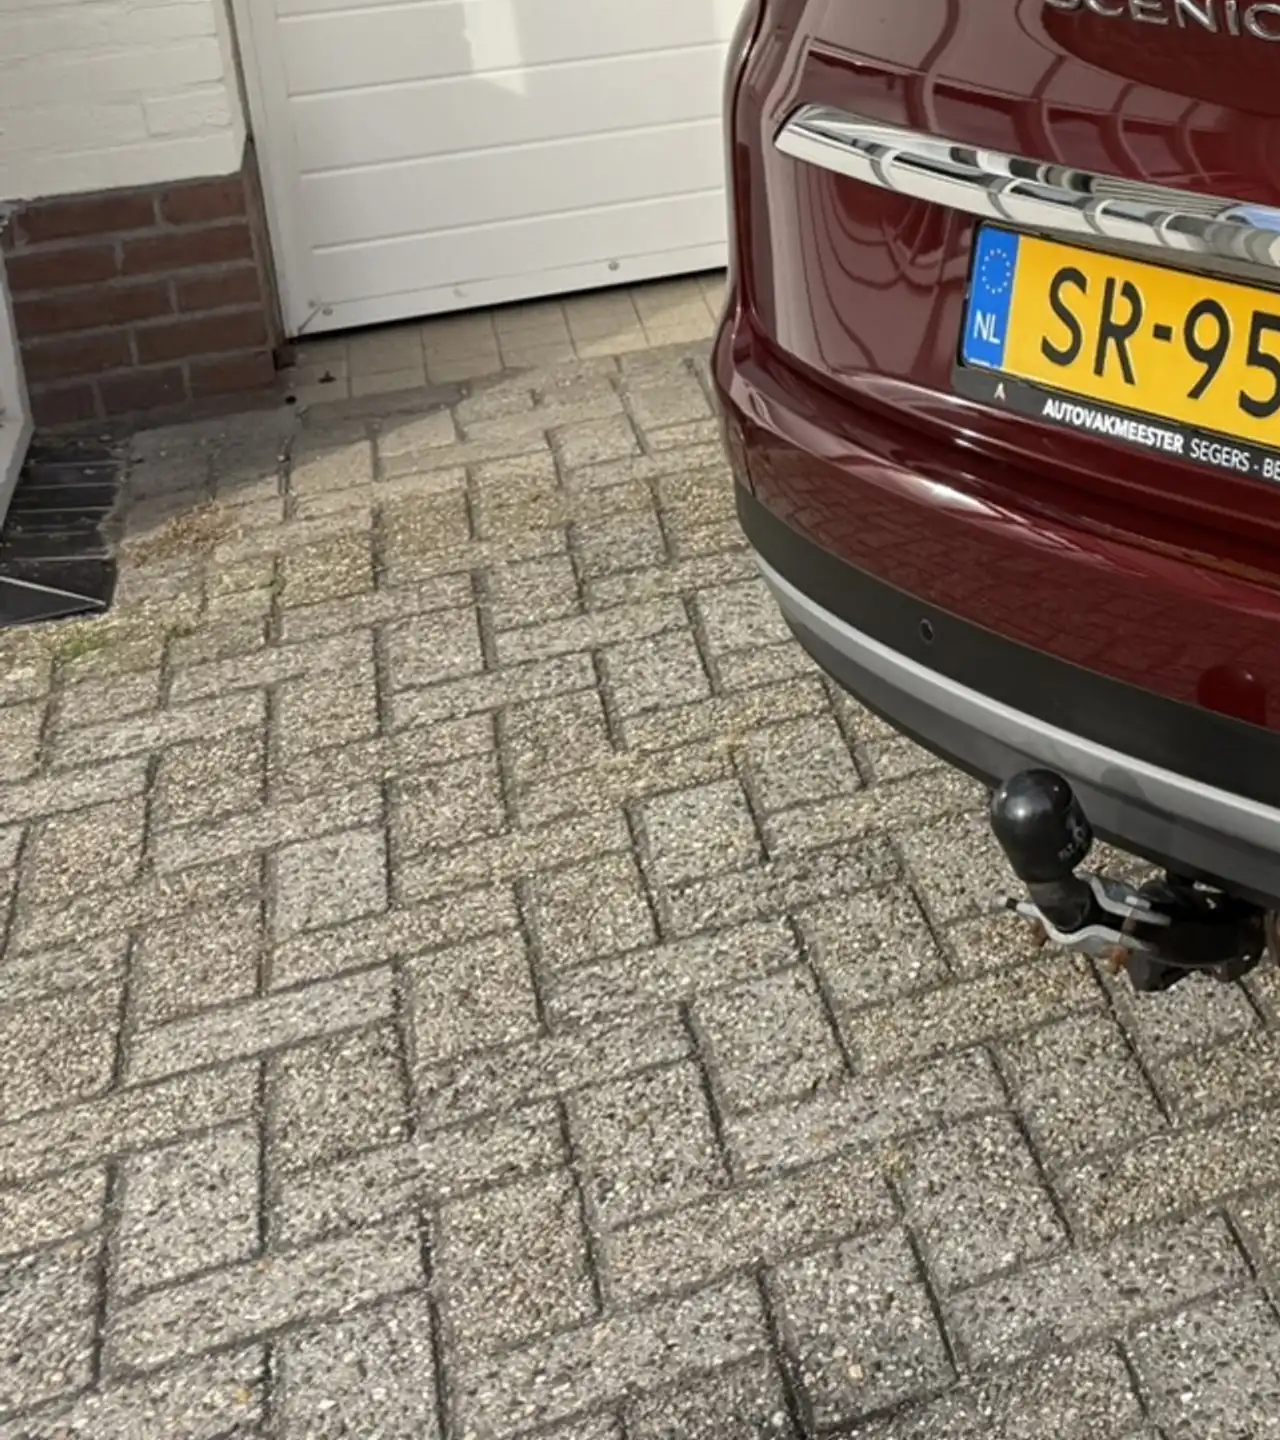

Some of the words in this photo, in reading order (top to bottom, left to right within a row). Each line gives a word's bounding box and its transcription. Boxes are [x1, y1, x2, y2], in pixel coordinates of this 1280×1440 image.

[973, 313, 1001, 345] NL
[1042, 397, 1185, 454] AUTOVAKMEESTER
[1189, 437, 1251, 472] SEGERS
